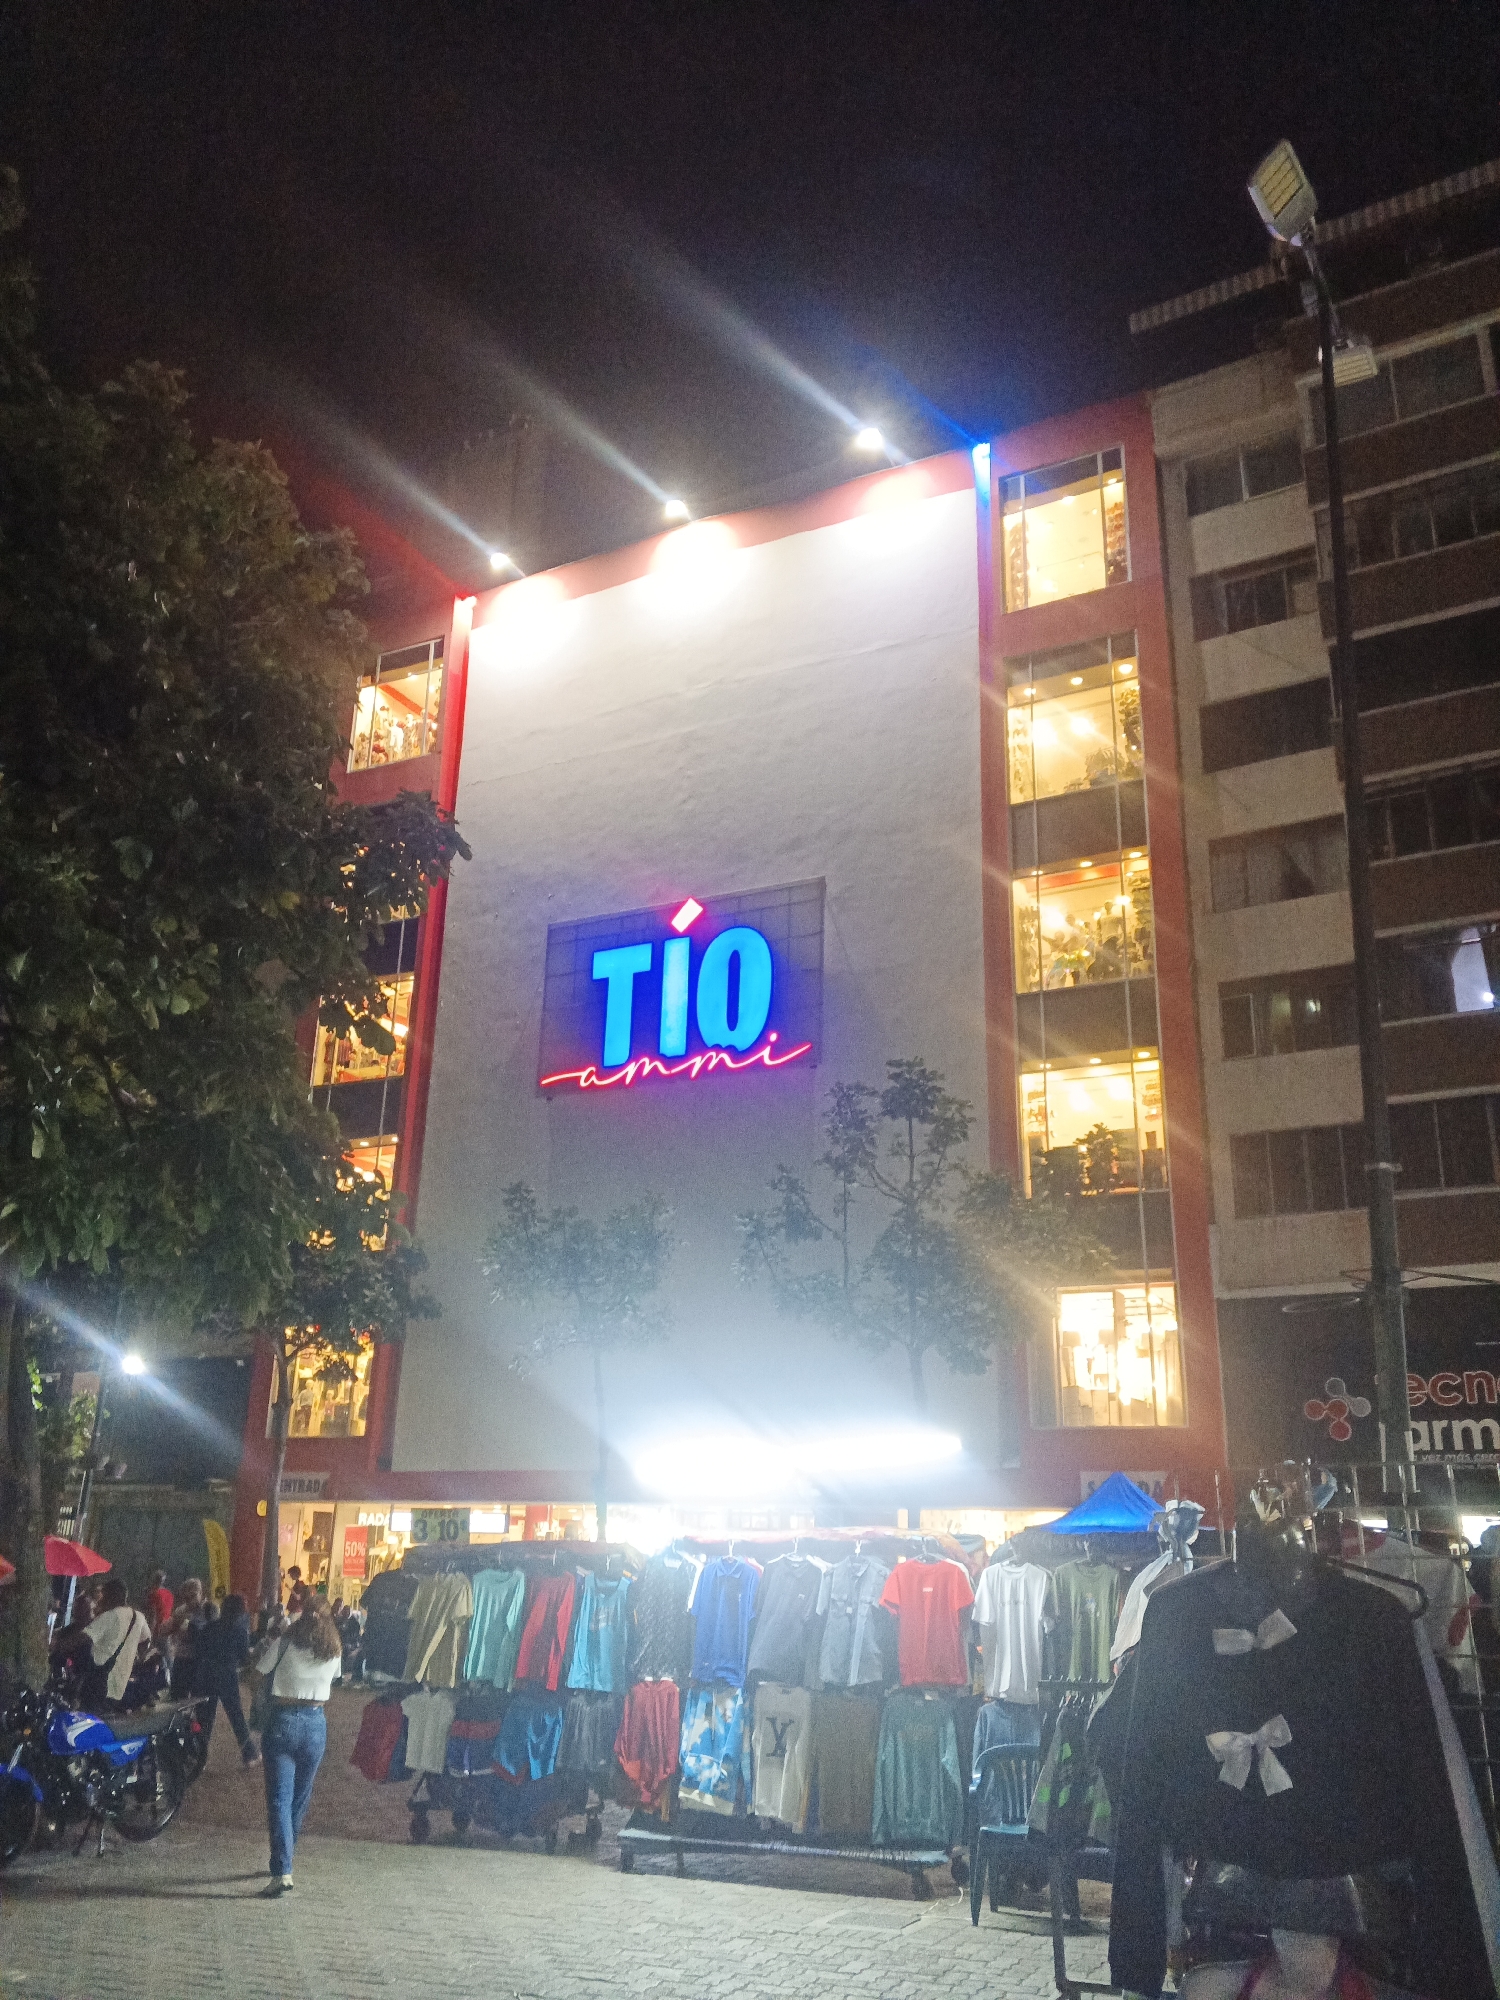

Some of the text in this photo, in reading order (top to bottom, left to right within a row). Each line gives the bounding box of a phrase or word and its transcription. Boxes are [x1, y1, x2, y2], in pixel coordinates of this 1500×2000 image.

[540, 1032, 813, 1088] ammi
[1406, 1370, 1500, 1407] ecn
[1409, 1418, 1500, 1451] arm
[412, 1518, 429, 1542] 3
[344, 1541, 366, 1557] 50%
